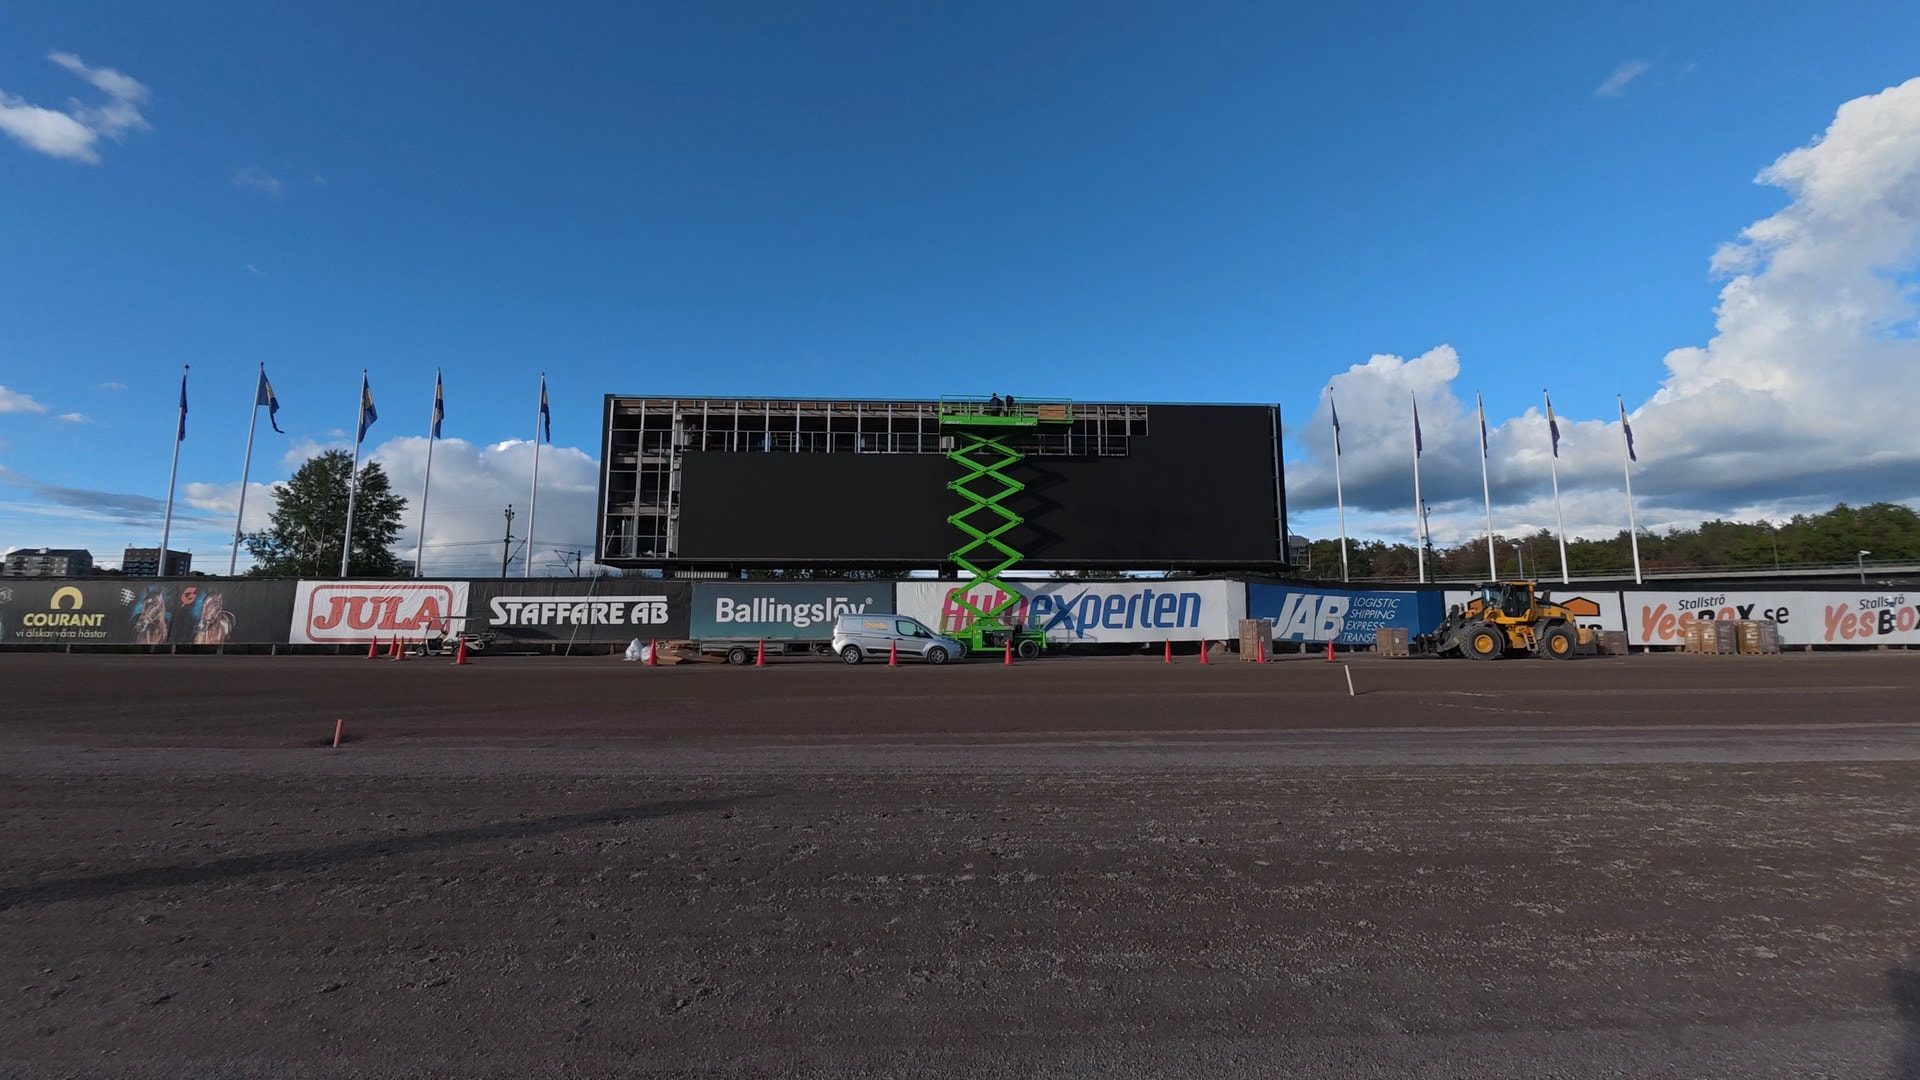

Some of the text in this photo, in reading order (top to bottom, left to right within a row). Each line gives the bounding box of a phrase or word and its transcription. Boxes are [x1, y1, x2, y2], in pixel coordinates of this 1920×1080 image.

[1353, 597, 1401, 609] LOGISTIC
[1859, 593, 1905, 611] Stallsrö
[313, 596, 443, 630] JULA
[489, 596, 669, 625] STAFFARE AB
[1264, 593, 1351, 640] JAB
[1350, 609, 1396, 620] SHIPPING
[23, 613, 105, 627] COURANT
[1345, 620, 1386, 632] EXPRESS
[16, 628, 108, 638] vi älskar våra hästar
[1342, 632, 1377, 643] TRANSP
